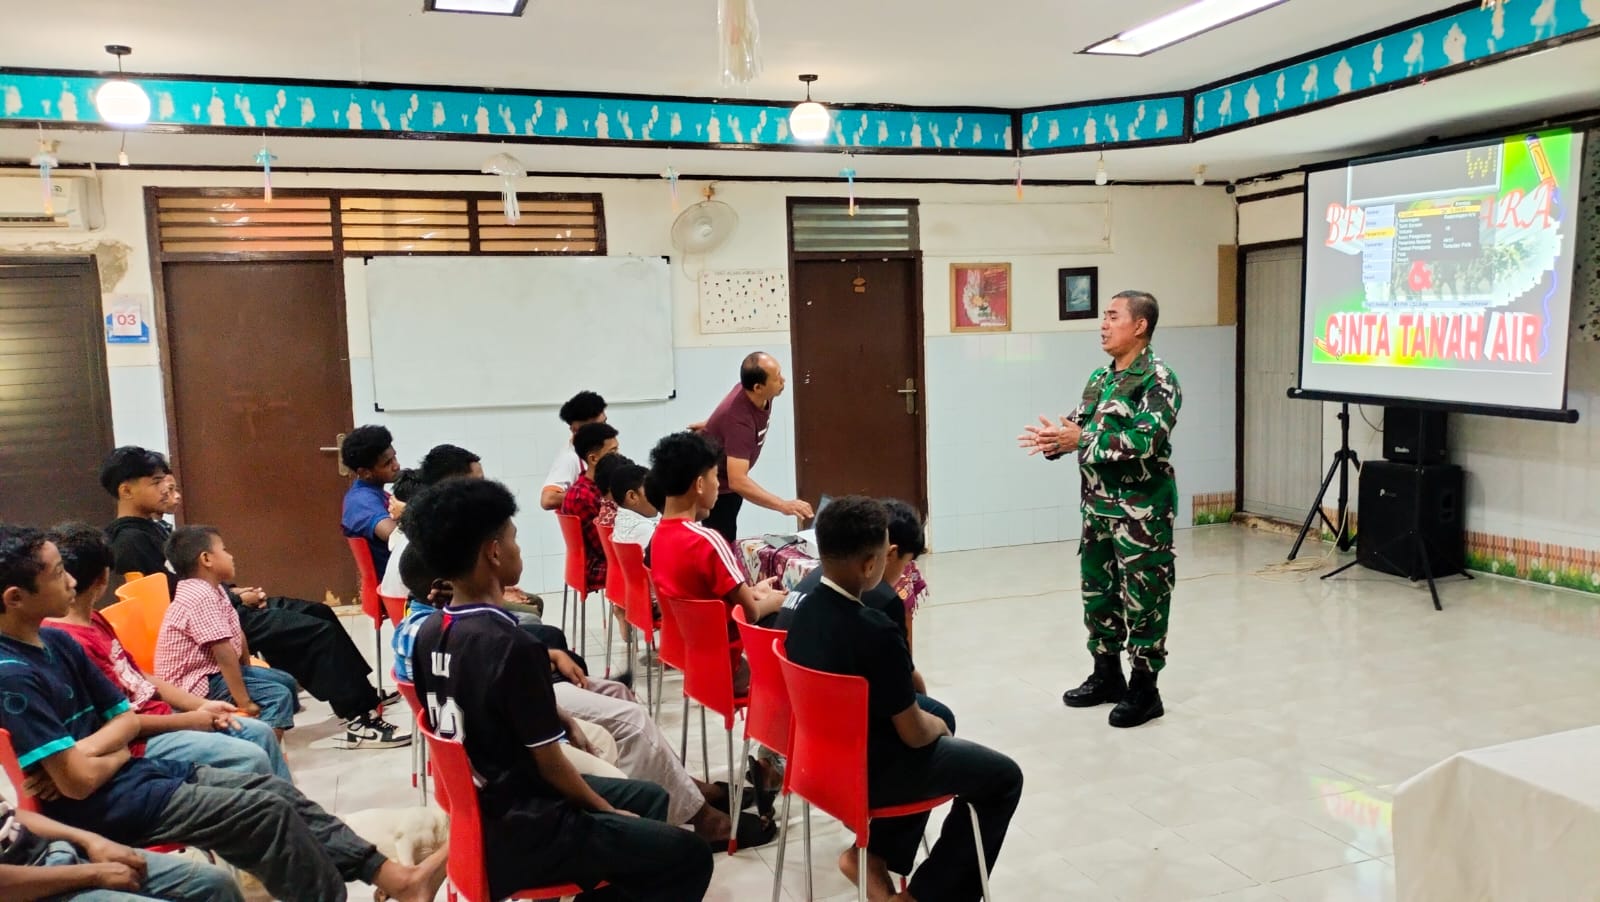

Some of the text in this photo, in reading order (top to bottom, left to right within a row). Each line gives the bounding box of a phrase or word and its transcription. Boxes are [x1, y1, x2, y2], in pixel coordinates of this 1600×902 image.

[1409, 261, 1433, 291] &
[117, 314, 136, 325] 03
[1325, 312, 1542, 364] CINTA TANAH AIR
